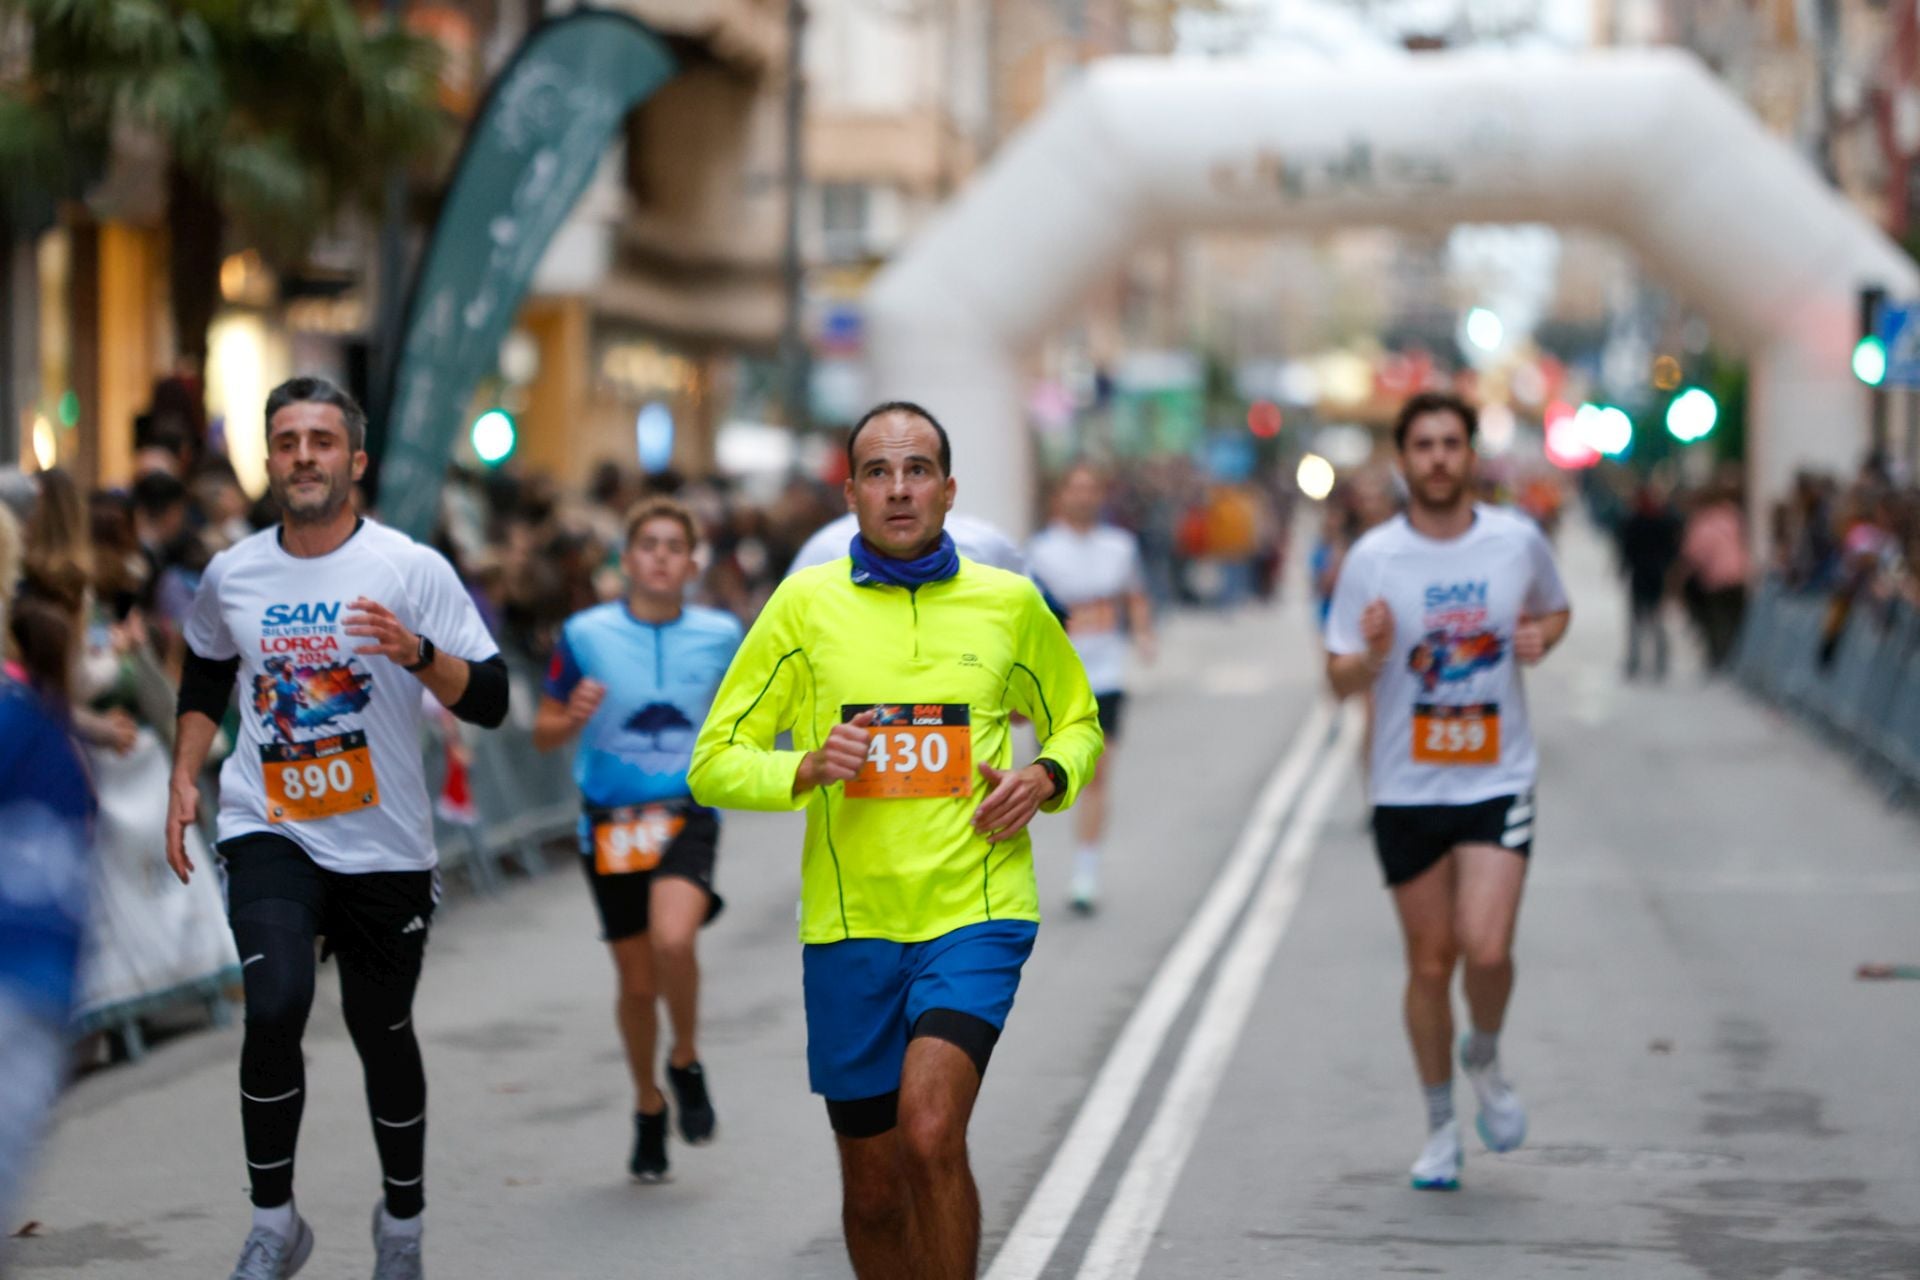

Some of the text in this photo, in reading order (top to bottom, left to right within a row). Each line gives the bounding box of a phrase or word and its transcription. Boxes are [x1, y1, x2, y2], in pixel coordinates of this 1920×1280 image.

[261, 601, 341, 626] SAN
[262, 625, 337, 637] SILVESTRE
[260, 636, 338, 653] LORCA
[867, 732, 949, 773] 430
[282, 759, 353, 800] 890
